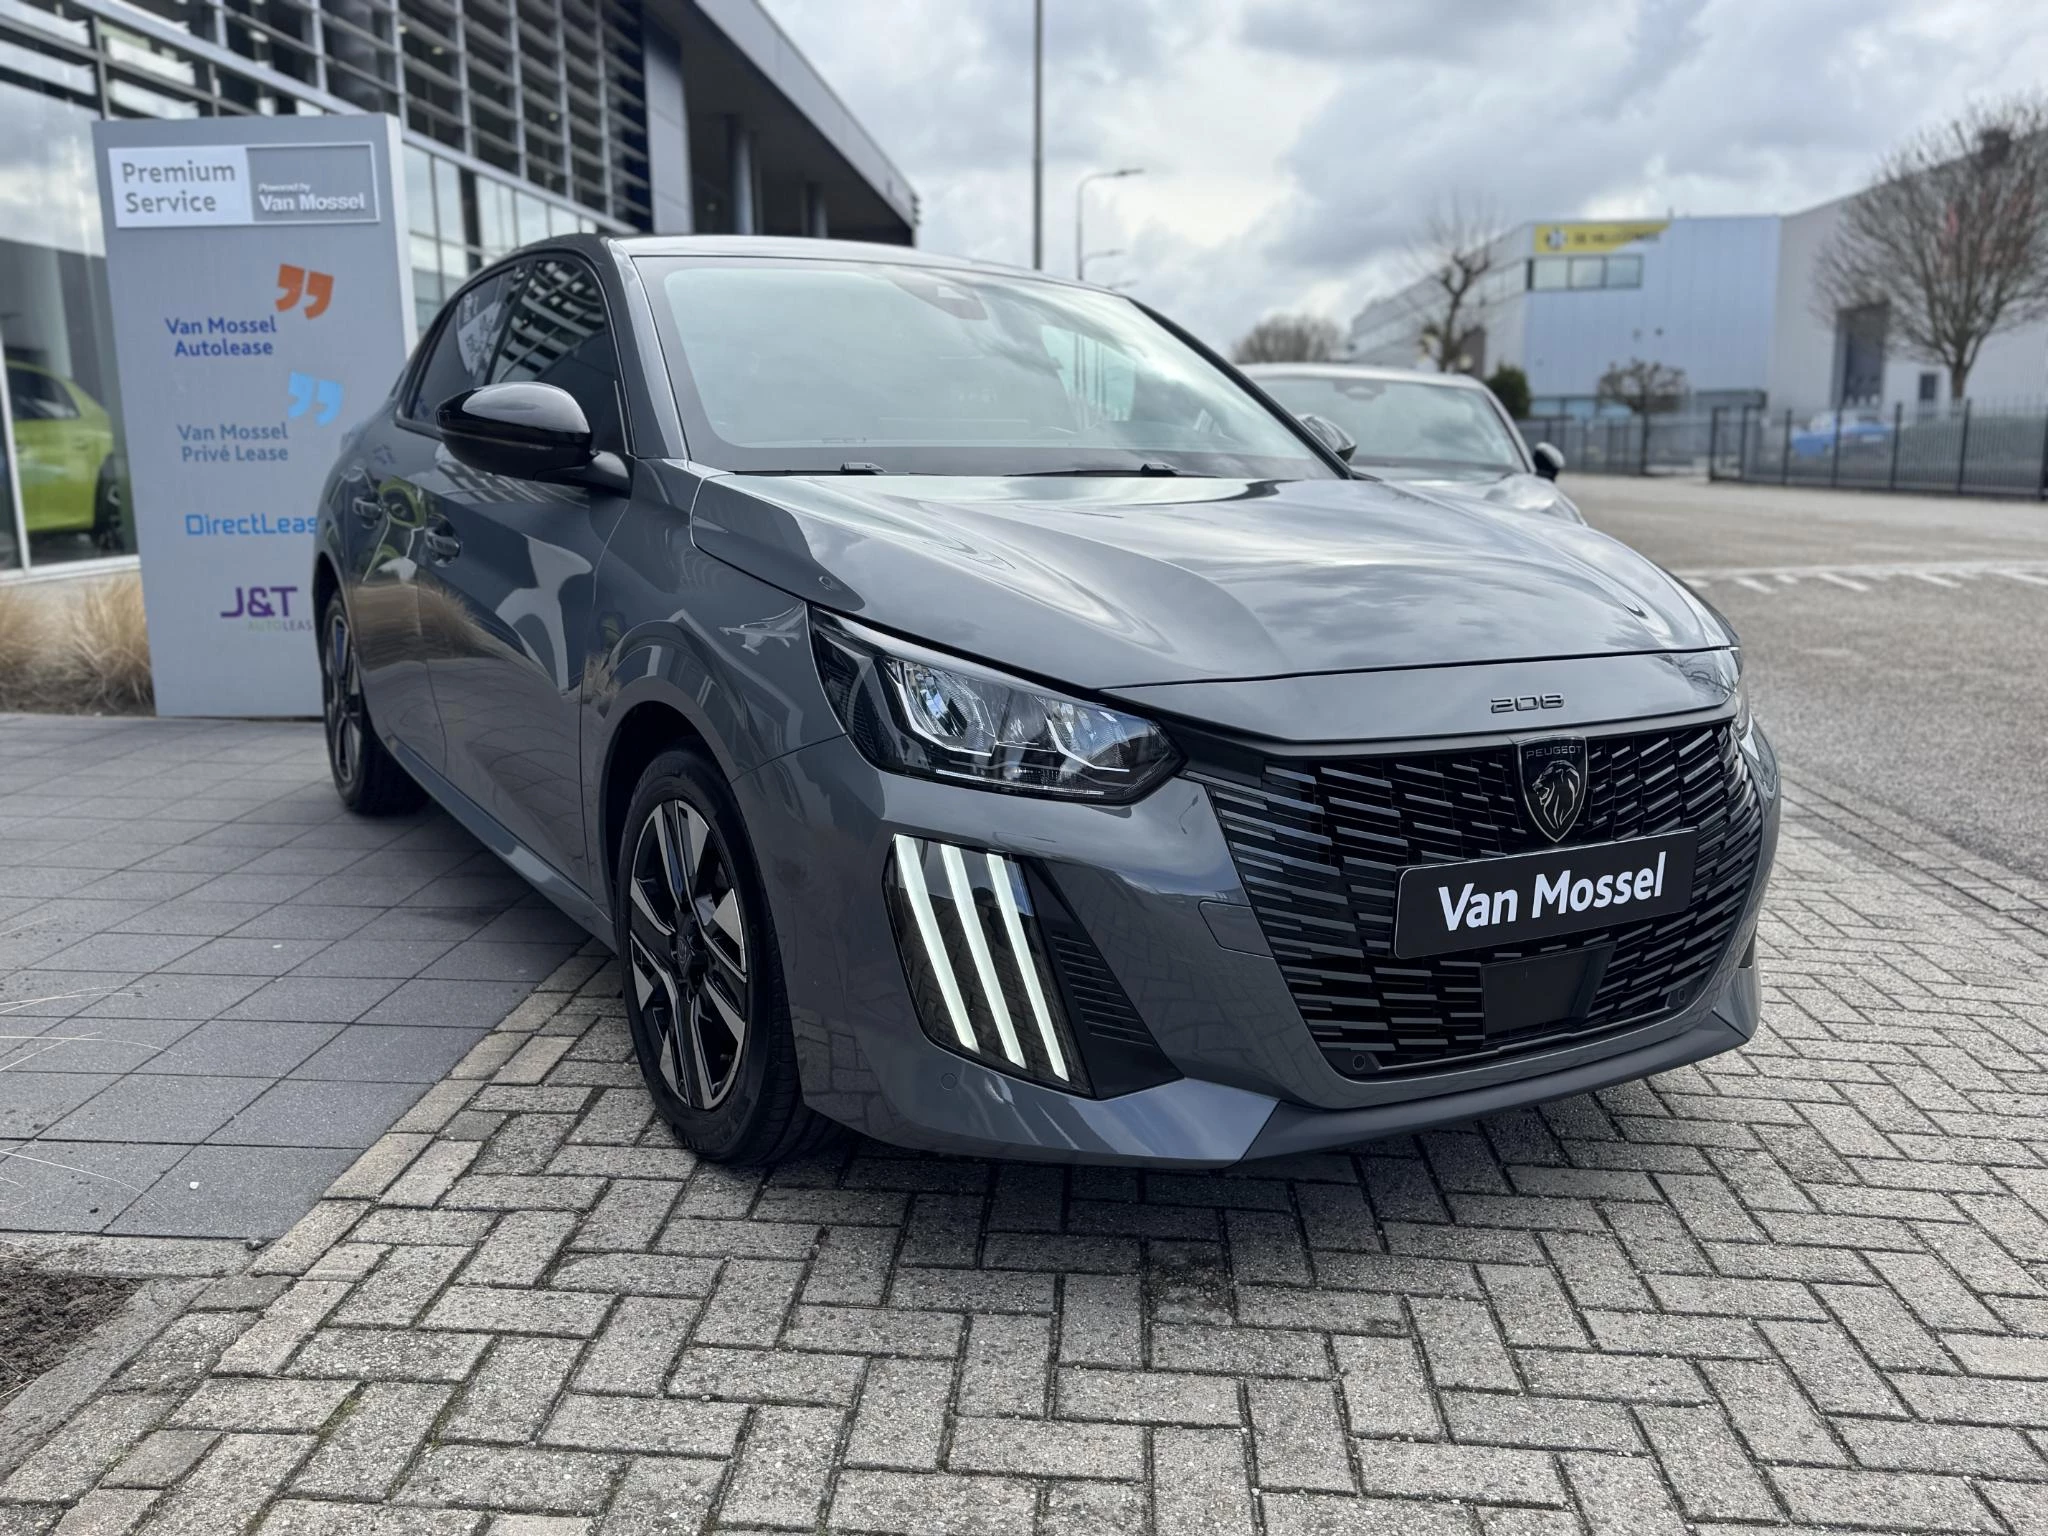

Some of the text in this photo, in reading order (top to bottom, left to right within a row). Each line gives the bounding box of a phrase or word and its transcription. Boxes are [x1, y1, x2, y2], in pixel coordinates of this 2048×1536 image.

[122, 159, 236, 183] Premium
[125, 190, 217, 214] Service
[259, 191, 365, 212] Van Mossel
[165, 314, 277, 335] Van Mossel
[174, 338, 274, 357] Autolease
[176, 421, 289, 441] Van Mossel
[181, 444, 289, 462] Privé Lease
[184, 513, 318, 536] DirectLeas
[220, 586, 298, 618] J&T
[247, 619, 314, 632] AUTOLEAS
[1490, 692, 1565, 714] 208
[1526, 745, 1582, 759] PEUGEOT
[1437, 850, 1667, 932] Van Mossel
